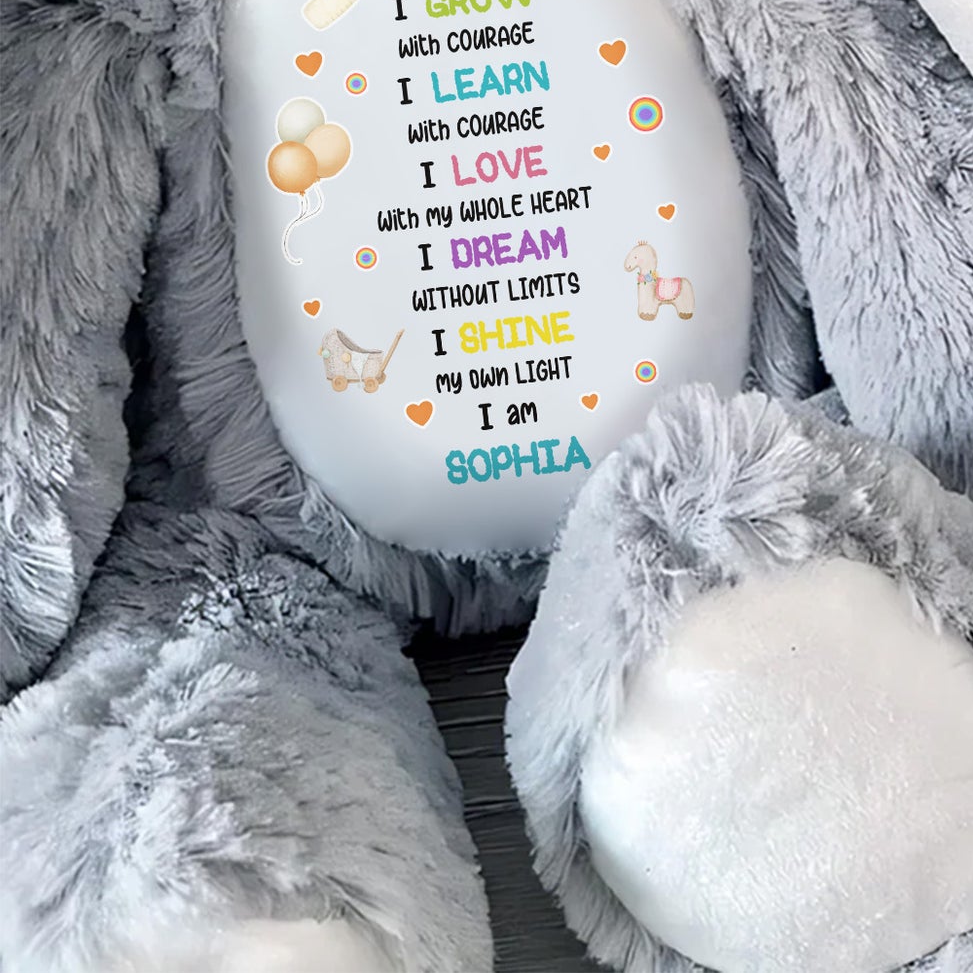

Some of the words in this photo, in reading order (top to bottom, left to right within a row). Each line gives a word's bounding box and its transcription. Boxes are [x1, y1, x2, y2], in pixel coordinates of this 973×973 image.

[447, 21, 534, 52] COURAGE
[397, 78, 413, 105] I
[431, 61, 550, 103] LEARN
[457, 107, 544, 138] COURAGE
[420, 161, 436, 188] I
[452, 146, 547, 185] LOVE
[460, 194, 524, 222] WHOLE
[530, 186, 591, 214] HEART
[418, 244, 433, 271] I
[451, 227, 567, 269] DREAM
[412, 280, 499, 311] WITHOUT
[508, 272, 580, 301] LIMITS
[432, 329, 447, 356] I
[459, 311, 575, 354] SHINE
[515, 356, 572, 384] LIGHT
[478, 403, 493, 430] I
[507, 402, 537, 425] am
[446, 436, 591, 485] SOPHIA
